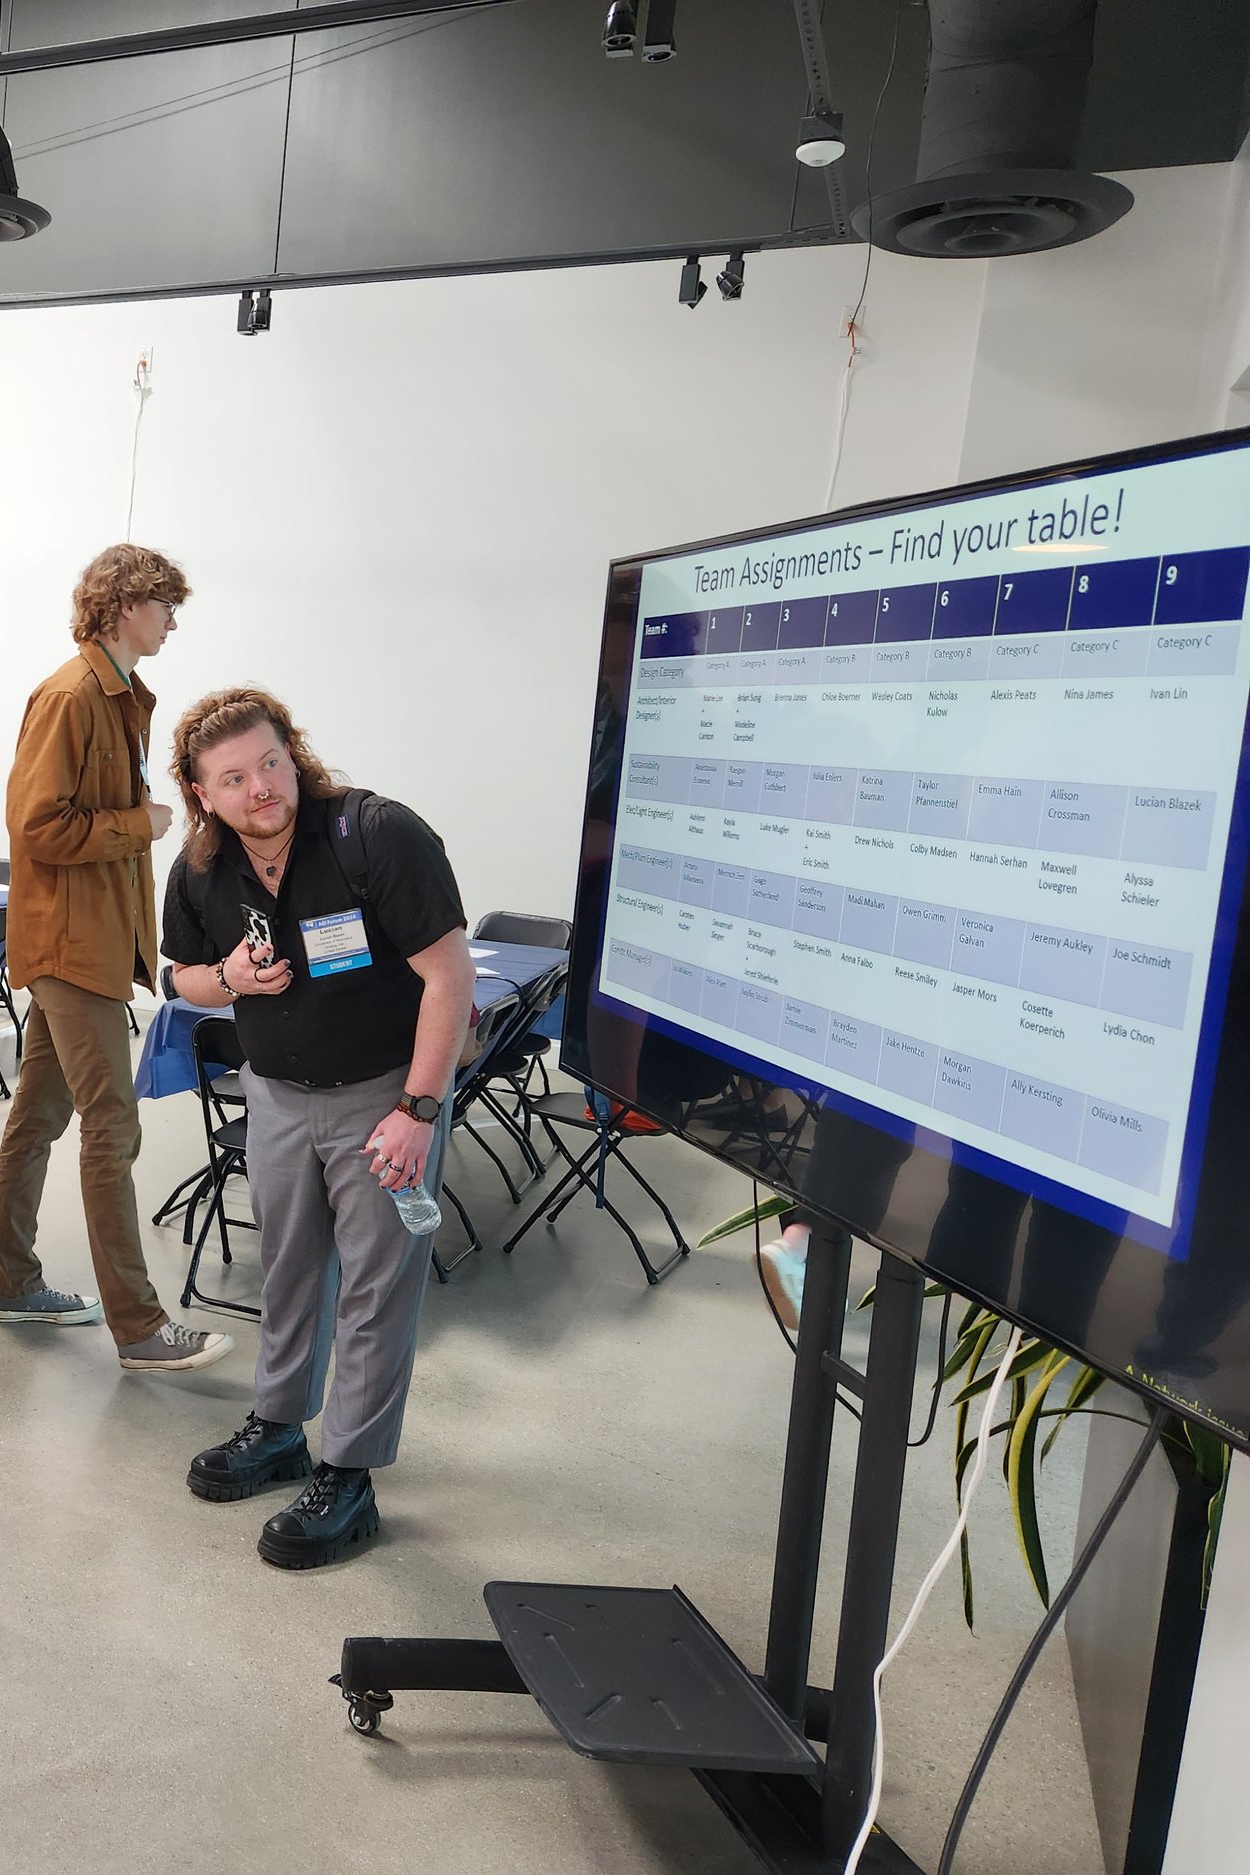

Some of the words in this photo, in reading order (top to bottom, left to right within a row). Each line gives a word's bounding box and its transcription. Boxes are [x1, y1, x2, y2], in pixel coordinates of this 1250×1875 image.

[695, 565, 735, 594] Team
[740, 542, 862, 590] Assignments
[890, 520, 944, 564] Find
[953, 518, 1017, 565] your
[1028, 488, 1123, 546] table!
[1166, 566, 1177, 585] 9
[1078, 575, 1089, 593] 8
[941, 591, 949, 606] 6
[1004, 584, 1013, 600] 7
[831, 603, 838, 617] 4
[882, 598, 890, 612] 5
[746, 613, 751, 626] 2
[783, 609, 790, 622] 3
[711, 617, 716, 629] 1
[645, 625, 661, 635] Team
[1071, 642, 1110, 654] Category
[1112, 640, 1119, 650] C
[1157, 637, 1203, 650] Category
[1205, 635, 1213, 646] C
[876, 653, 903, 663] Category
[905, 651, 909, 660] B
[934, 649, 966, 659] Category
[966, 648, 972, 657] B
[997, 646, 1031, 657] Category
[1033, 644, 1040, 654] C
[779, 657, 800, 667] Category
[801, 657, 805, 665] A
[826, 655, 850, 665] Category
[851, 654, 856, 662] B
[640, 668, 656, 678] Design
[660, 667, 685, 679] Category
[738, 694, 748, 702] Brian
[792, 694, 807, 702] Jones
[822, 693, 837, 701] Chloe
[838, 693, 861, 701] Boerner
[872, 692, 893, 702] Wesley
[895, 692, 912, 701] Coats
[929, 690, 958, 701] Nicholas
[991, 690, 1013, 700] Alexis
[1016, 690, 1037, 700] Peats
[1064, 689, 1084, 699] Nina
[1086, 689, 1114, 699] James
[1150, 688, 1171, 699] Ivan
[1174, 688, 1188, 699] Lin
[927, 707, 948, 717] Kulow
[630, 760, 660, 771] Sustainability
[766, 769, 785, 779] Morgan
[812, 772, 824, 781] Julia
[629, 775, 659, 787] Consultant(s)
[862, 776, 883, 786] Katrina
[918, 780, 939, 791] Taylor
[765, 783, 786, 793] Cuthbert
[978, 784, 1002, 795] Emma
[1004, 786, 1022, 796] Hain
[860, 791, 885, 802] Bauman
[1050, 789, 1079, 801] Allison
[916, 796, 958, 809] Pfannenstiel
[1135, 796, 1166, 808] Lucian
[1169, 798, 1202, 811] Blazek
[648, 808, 674, 822] Engineer(s)
[1048, 808, 1090, 821] Crossman
[760, 822, 771, 831] Luke
[806, 829, 814, 838] Kai
[816, 830, 831, 840] Smith
[855, 835, 870, 846] Drew
[872, 838, 894, 849] Nichols
[910, 843, 928, 855] Colby
[930, 846, 957, 859] Madsen
[646, 854, 672, 869] Engineer(s)
[803, 857, 812, 866] Eric
[813, 859, 829, 870] Smith
[970, 851, 998, 864] Hannah
[1000, 854, 1028, 868] Serhan
[1041, 861, 1077, 875] Maxwell
[754, 876, 766, 886] Gage
[1039, 879, 1077, 894] Lovegren
[1124, 873, 1154, 887] Alyssa
[752, 889, 779, 901] Sutherland
[800, 885, 823, 898] Geoffrey
[616, 894, 637, 907] Structural
[638, 899, 663, 915] Engineer(s)
[798, 899, 826, 912] Sanderson
[848, 895, 863, 905] Madi
[864, 898, 885, 910] Mahan
[1121, 892, 1160, 907] Schieler
[902, 906, 922, 918] Owen
[923, 910, 946, 922] Grimm
[961, 917, 994, 932] Veronica
[959, 934, 984, 947] Galvan
[1031, 931, 1062, 948] Jeremy
[1063, 938, 1094, 954] Aukley
[747, 941, 776, 957] Scarborough
[794, 940, 816, 953] Stephen
[816, 945, 832, 957] Smith
[330, 960, 353, 969] STUDENT
[841, 953, 856, 965] Anna
[858, 957, 873, 968] Falbo
[1113, 949, 1129, 961] Joe
[1131, 952, 1171, 970] Schmidt
[895, 967, 915, 980] Reese
[916, 972, 937, 987] Smiley
[953, 982, 976, 997] Jasper
[977, 988, 997, 1002] Mors
[786, 1003, 801, 1014] Jamie
[1022, 1000, 1054, 1018] Cosette
[784, 1016, 816, 1034] Zimmerman
[833, 1019, 857, 1034] Brayden
[1020, 1018, 1065, 1039] Koerperich
[1103, 1022, 1127, 1039] Lydia
[1130, 1029, 1155, 1045] Chon
[832, 1033, 858, 1050] Martinez
[886, 1037, 900, 1050] Jake
[901, 1043, 925, 1057] Hentze
[944, 1056, 971, 1073] Morgan
[942, 1072, 971, 1090] Dawkins
[1011, 1079, 1027, 1093] Ally
[1028, 1085, 1063, 1107] Kersting
[1091, 1107, 1117, 1123] Olivia
[1120, 1114, 1143, 1132] Mills
